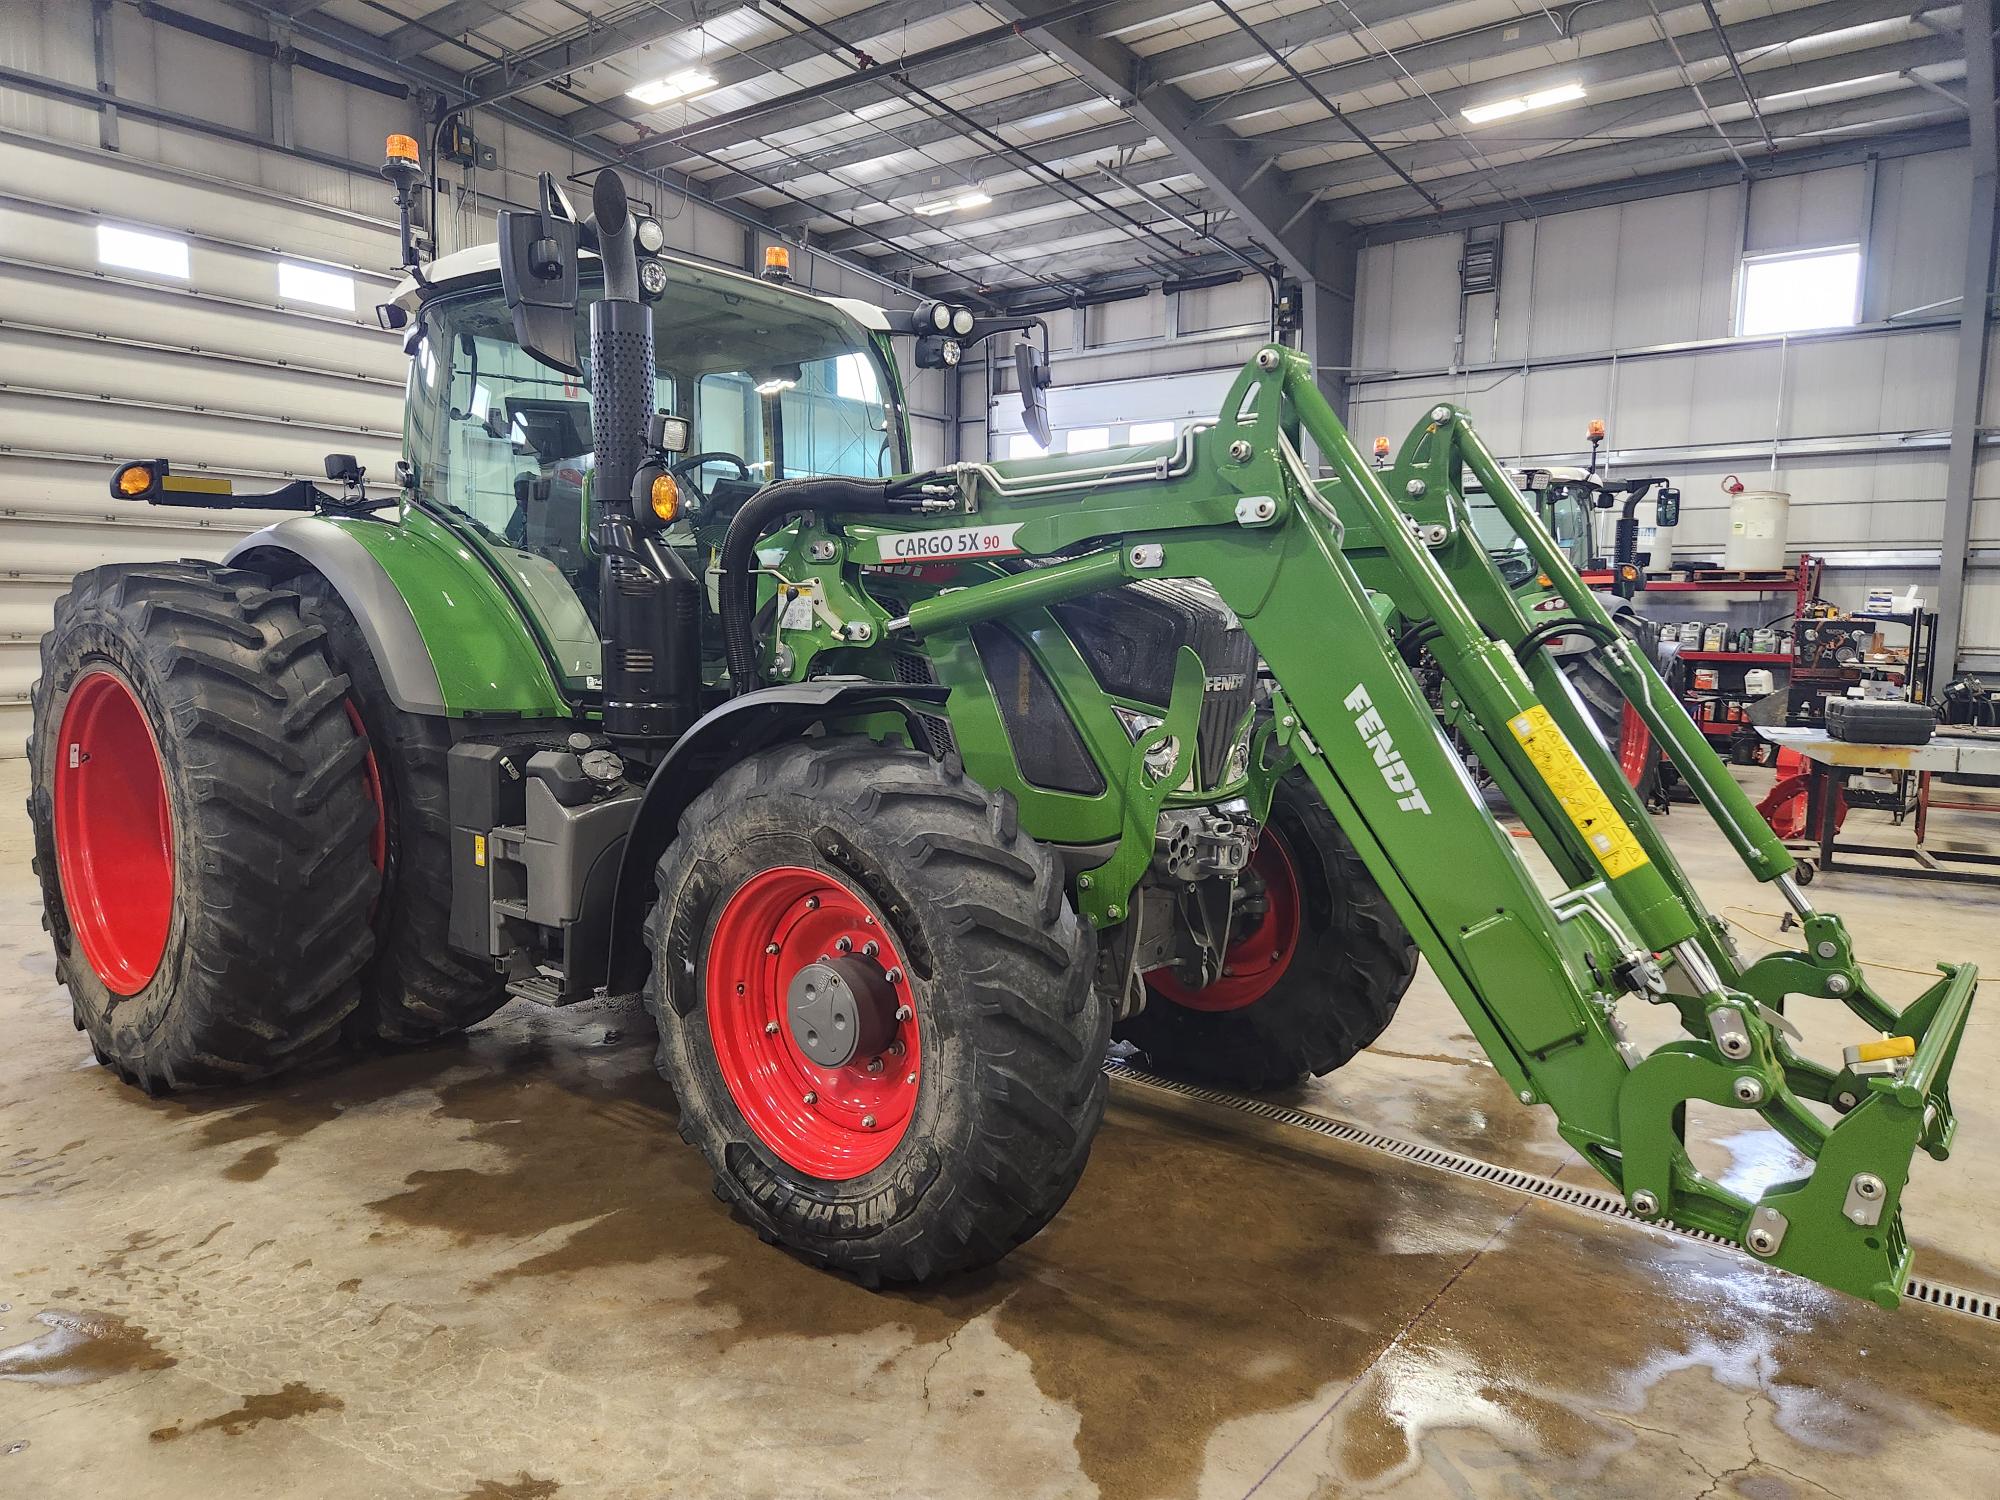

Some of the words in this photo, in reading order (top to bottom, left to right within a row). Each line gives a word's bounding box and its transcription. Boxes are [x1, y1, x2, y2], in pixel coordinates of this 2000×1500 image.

[894, 535, 953, 557] CARGO
[958, 532, 979, 552] 5X
[983, 535, 1000, 550] 90
[1204, 673, 1247, 692] FENDT
[1343, 682, 1432, 815] FENDT
